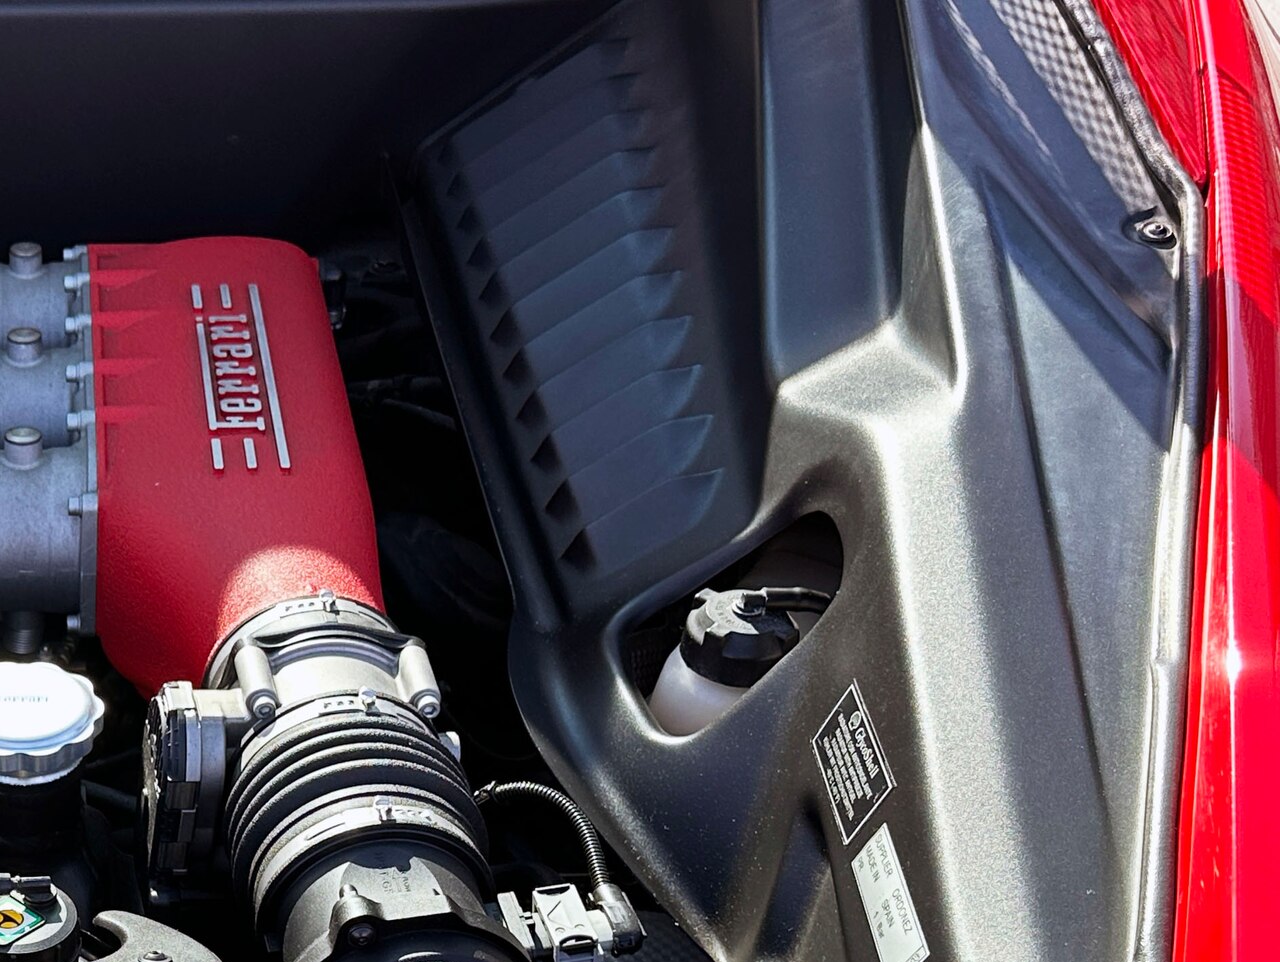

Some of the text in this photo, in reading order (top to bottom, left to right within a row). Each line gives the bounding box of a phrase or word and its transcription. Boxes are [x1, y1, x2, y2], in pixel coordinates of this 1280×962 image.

[195, 314, 266, 431] Ferrari
[855, 727, 879, 779] GlycoShell
[866, 844, 895, 928] MADE IN SPAIN
[875, 833, 912, 936] SUPPLIER ORDONEZ
